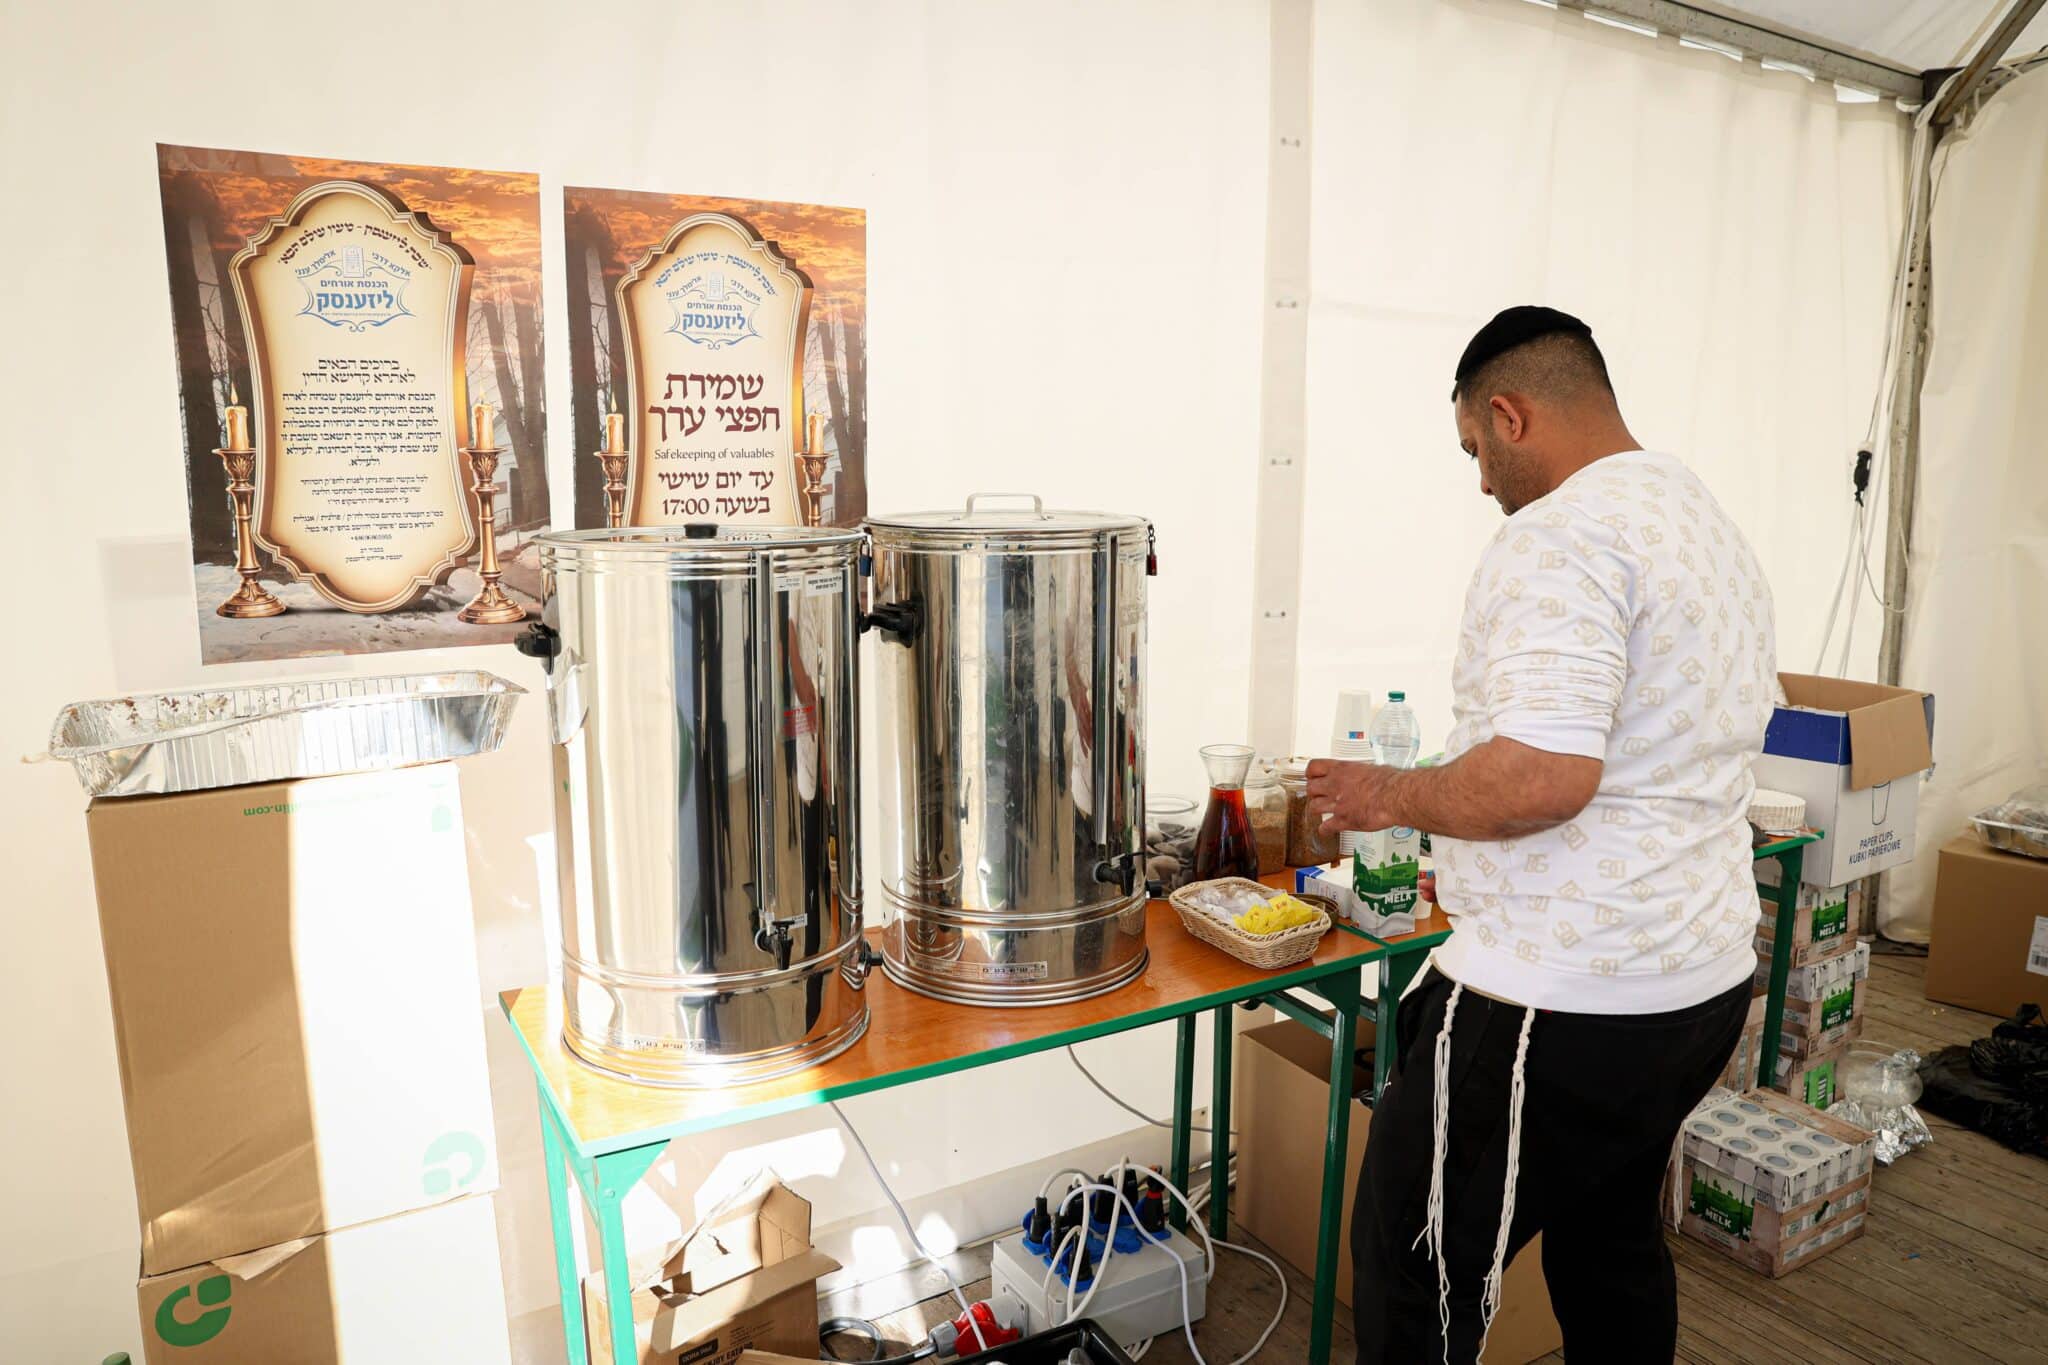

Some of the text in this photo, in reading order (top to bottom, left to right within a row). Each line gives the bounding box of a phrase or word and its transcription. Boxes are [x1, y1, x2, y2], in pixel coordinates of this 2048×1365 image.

[320, 279, 388, 288] הכנסת אורחים
[316, 290, 394, 312] ליזענסק
[687, 302, 742, 312] הכנסת אורחים
[682, 313, 746, 331] ליזענסק
[318, 359, 400, 370] ברוכים הבאים
[302, 368, 416, 387] לאתרא קדישא הדין
[664, 372, 764, 400] שמירת
[375, 393, 405, 401] אורחים
[408, 393, 436, 401] הכנסת
[308, 406, 330, 414] רבים
[409, 406, 434, 414] אתכם
[382, 419, 395, 427] את
[397, 416, 414, 427] לכם
[415, 416, 439, 429] לספק
[648, 405, 780, 442] חפצי ערך
[399, 445, 420, 453] שבת
[654, 448, 775, 462] Safekeeping of valuables
[658, 470, 774, 491] עד יום שישי
[662, 496, 771, 517] בשעה 17:00
[1859, 830, 1894, 849] PAPER CUPS
[1849, 839, 1901, 864] KUBKI PAPIEROWE
[1384, 892, 1411, 904] MELK
[1819, 925, 1836, 937] MELK
[1705, 1207, 1732, 1228] MELK
